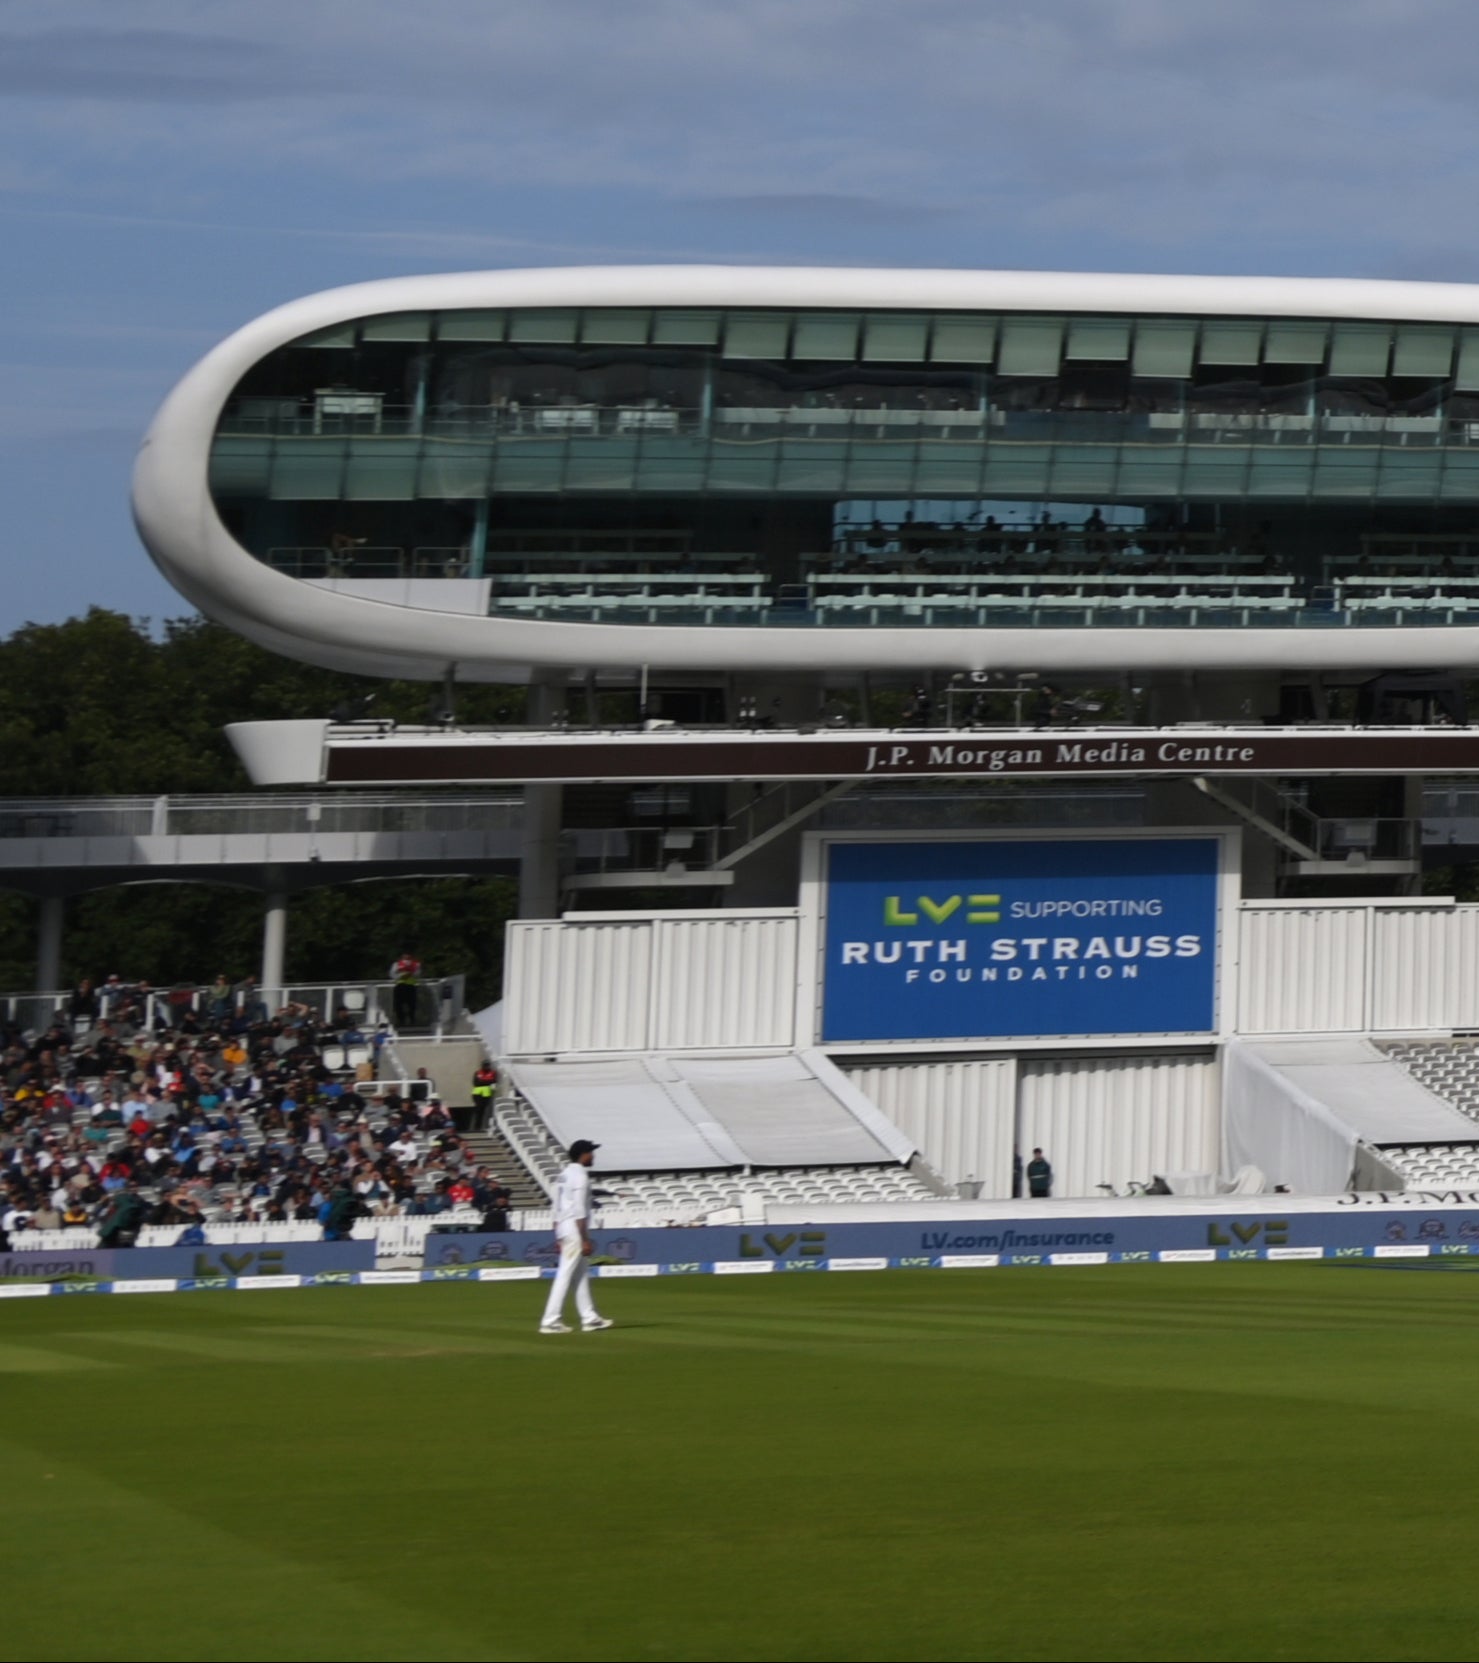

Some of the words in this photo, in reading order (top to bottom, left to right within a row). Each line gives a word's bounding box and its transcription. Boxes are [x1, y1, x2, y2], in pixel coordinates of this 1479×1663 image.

[865, 747, 914, 771] J.P.
[928, 745, 1042, 770] Morgan
[1056, 743, 1146, 763] Media
[1158, 741, 1255, 762] Centre
[1010, 898, 1163, 919] SUPPORTING
[842, 938, 968, 965] RUTH
[989, 935, 1202, 962] STRAUSS
[906, 964, 1139, 984] FOUNDATION
[920, 1229, 1114, 1253] LV.com/insurance
